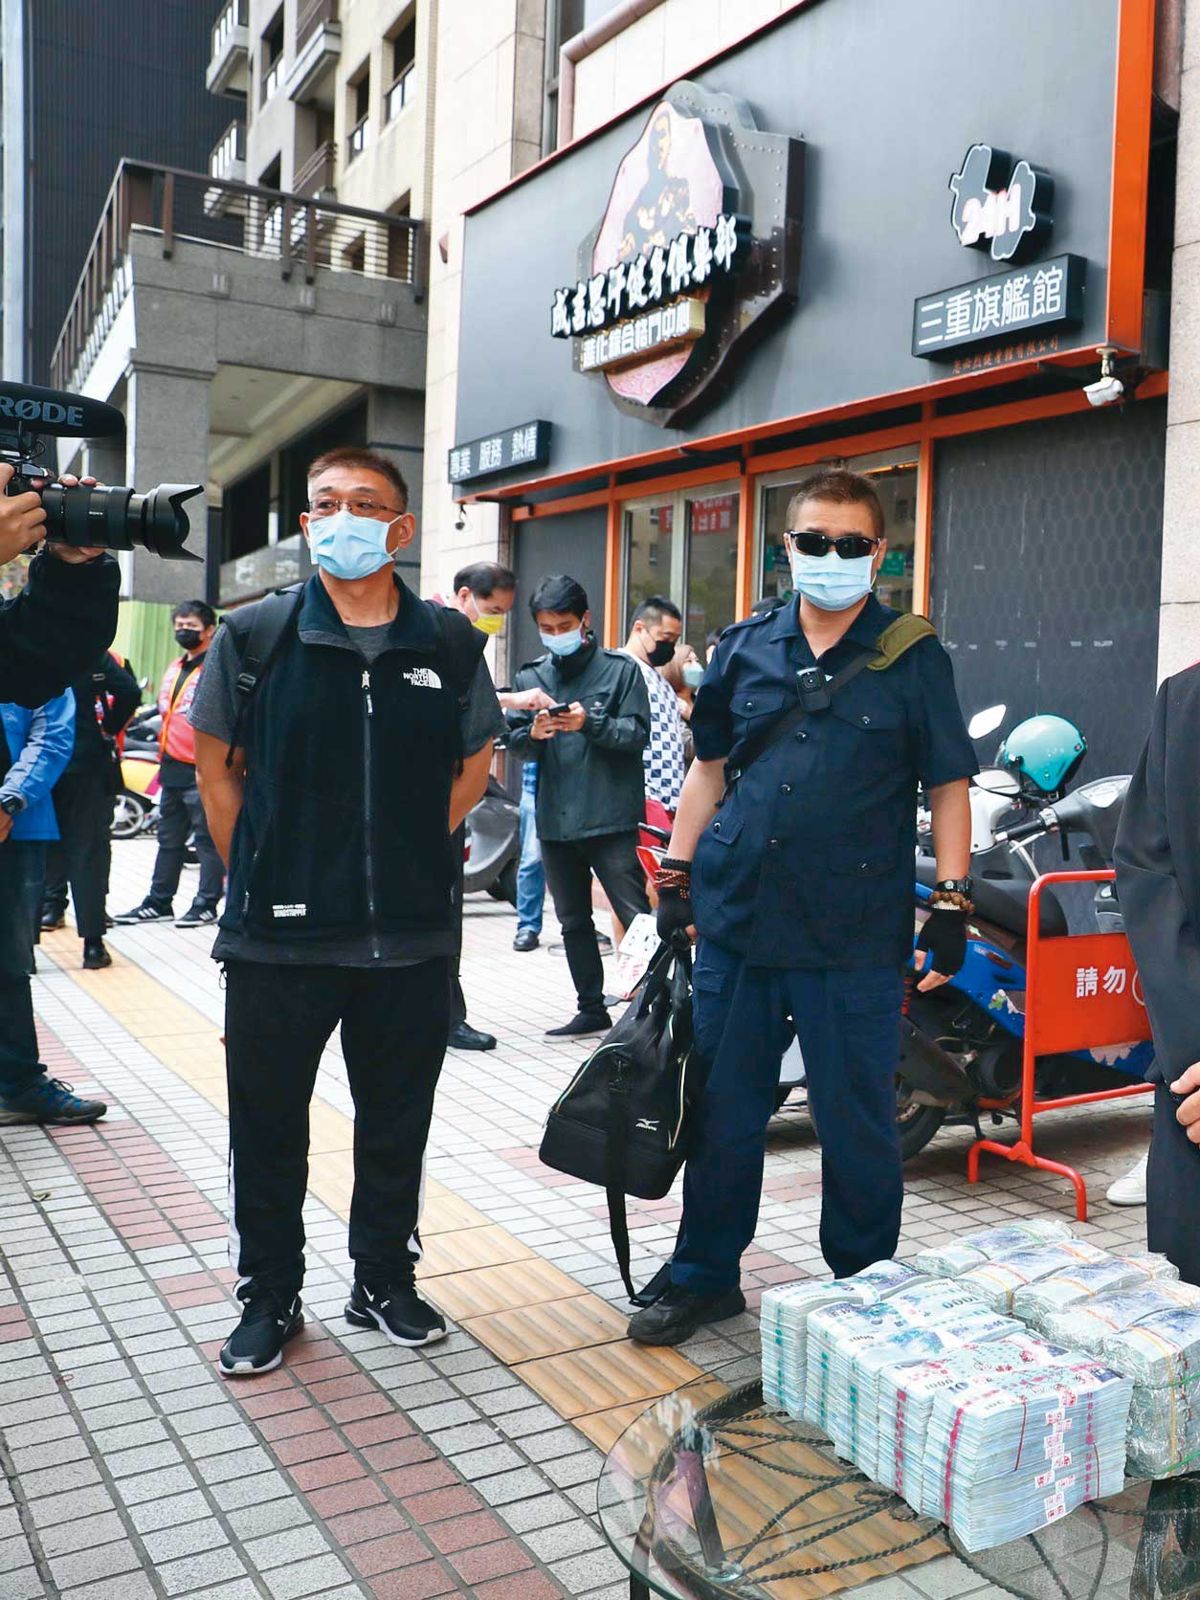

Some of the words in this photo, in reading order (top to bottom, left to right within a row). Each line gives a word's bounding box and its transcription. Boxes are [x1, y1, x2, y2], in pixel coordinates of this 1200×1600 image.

[961, 184, 1021, 246] 24H
[552, 215, 738, 337] 成吉思汗健身俱樂部
[918, 266, 1064, 346] 三重旗艦館
[478, 438, 503, 471] 服務
[511, 425, 537, 462] 熱情
[1076, 965, 1127, 999] 請勿
